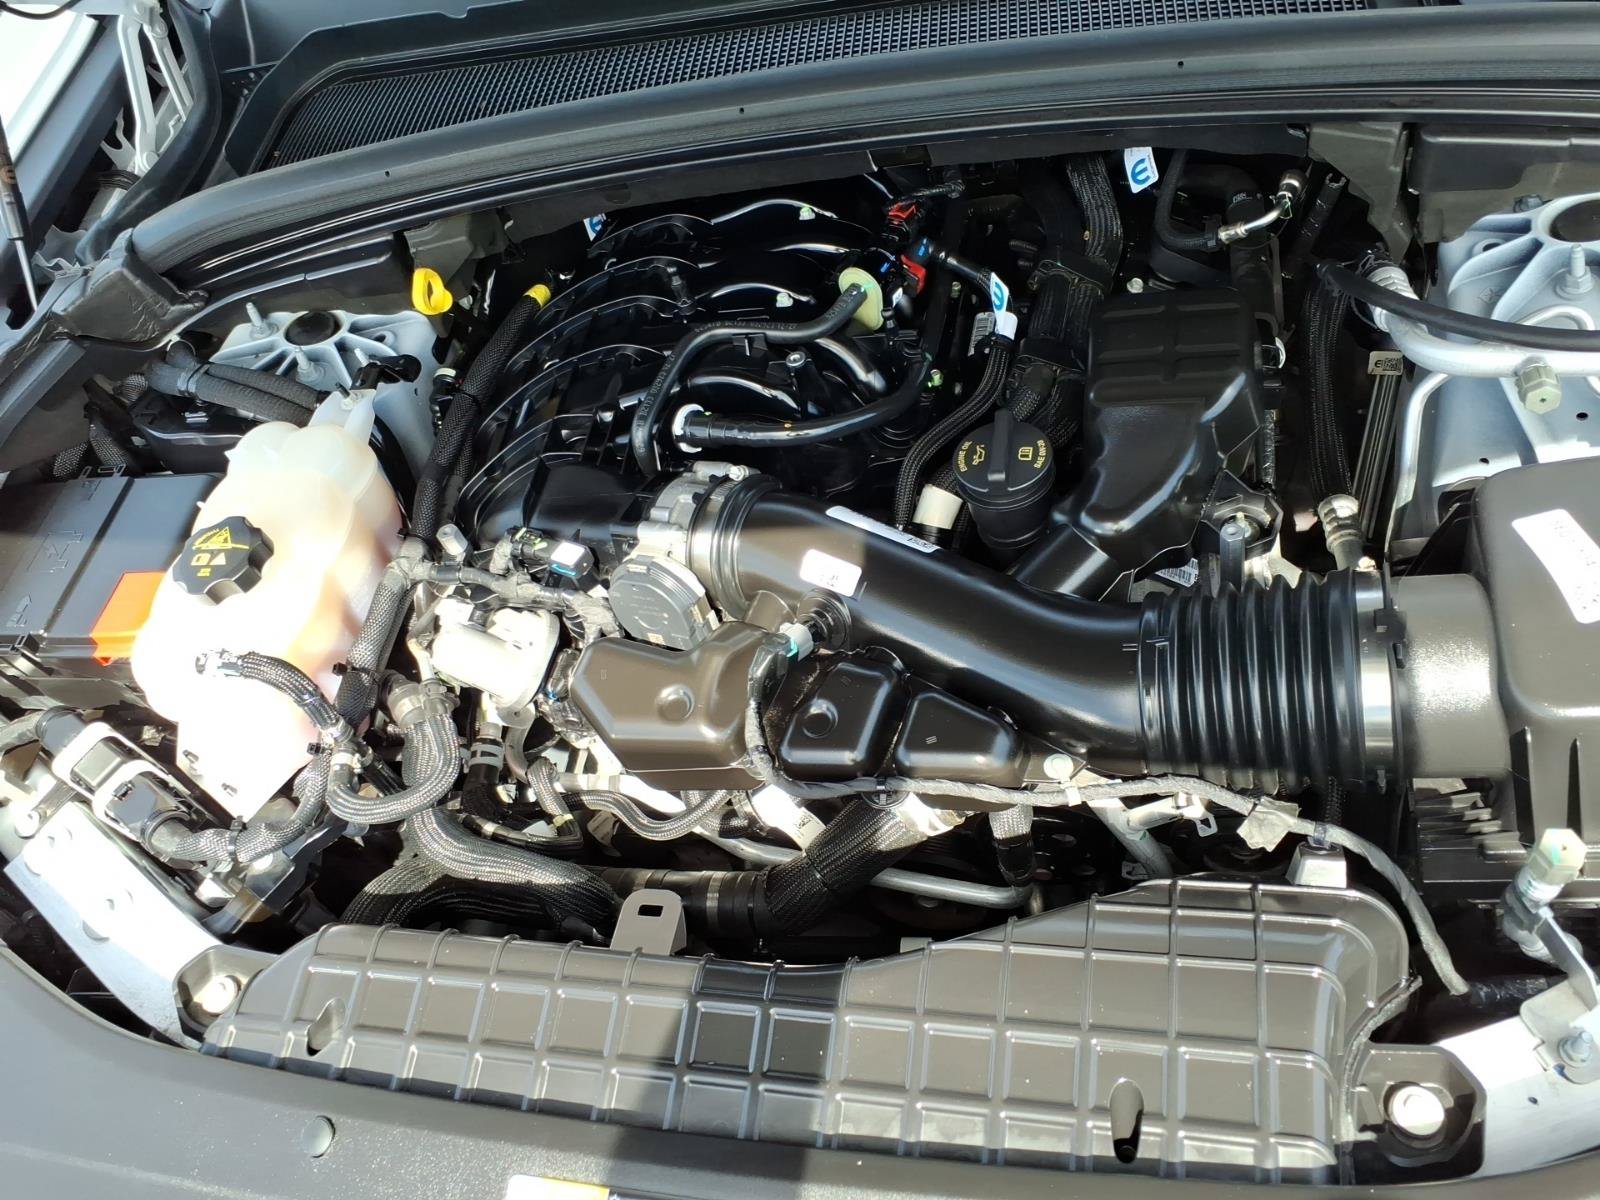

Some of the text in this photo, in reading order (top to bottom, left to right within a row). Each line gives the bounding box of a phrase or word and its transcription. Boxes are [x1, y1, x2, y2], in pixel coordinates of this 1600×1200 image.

[958, 441, 973, 472] ENGINE OIL
[1033, 456, 1045, 469] SAE
